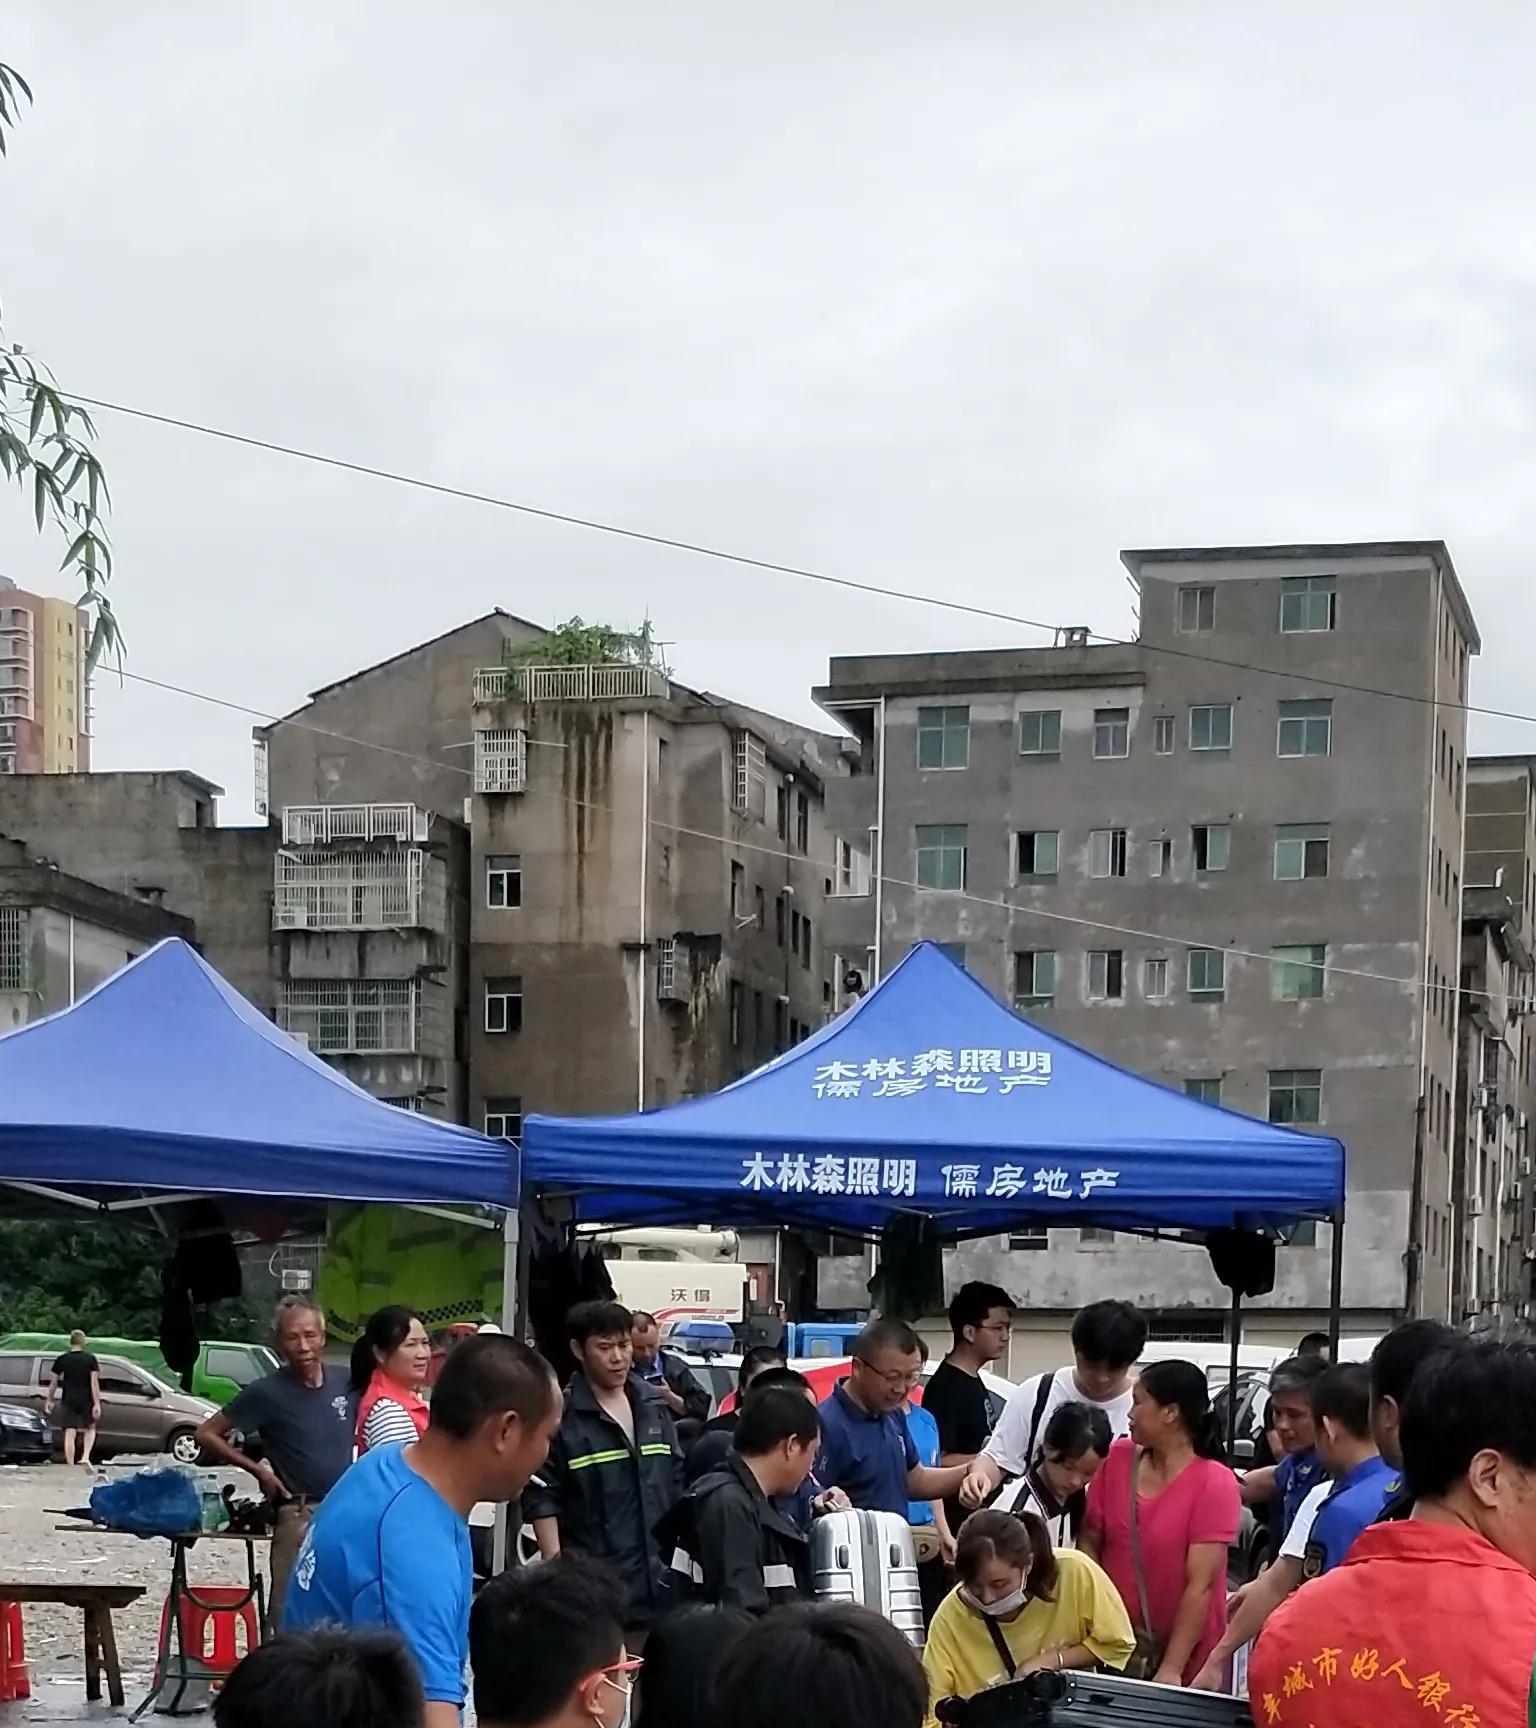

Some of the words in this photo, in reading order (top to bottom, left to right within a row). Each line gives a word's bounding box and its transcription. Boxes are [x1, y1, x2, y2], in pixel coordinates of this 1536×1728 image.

[813, 1049, 1052, 1081] 木林森照明
[812, 1074, 1052, 1099] 儒房地产
[740, 1151, 918, 1197] 木林森照明
[940, 1162, 1121, 1200] 儒房地产
